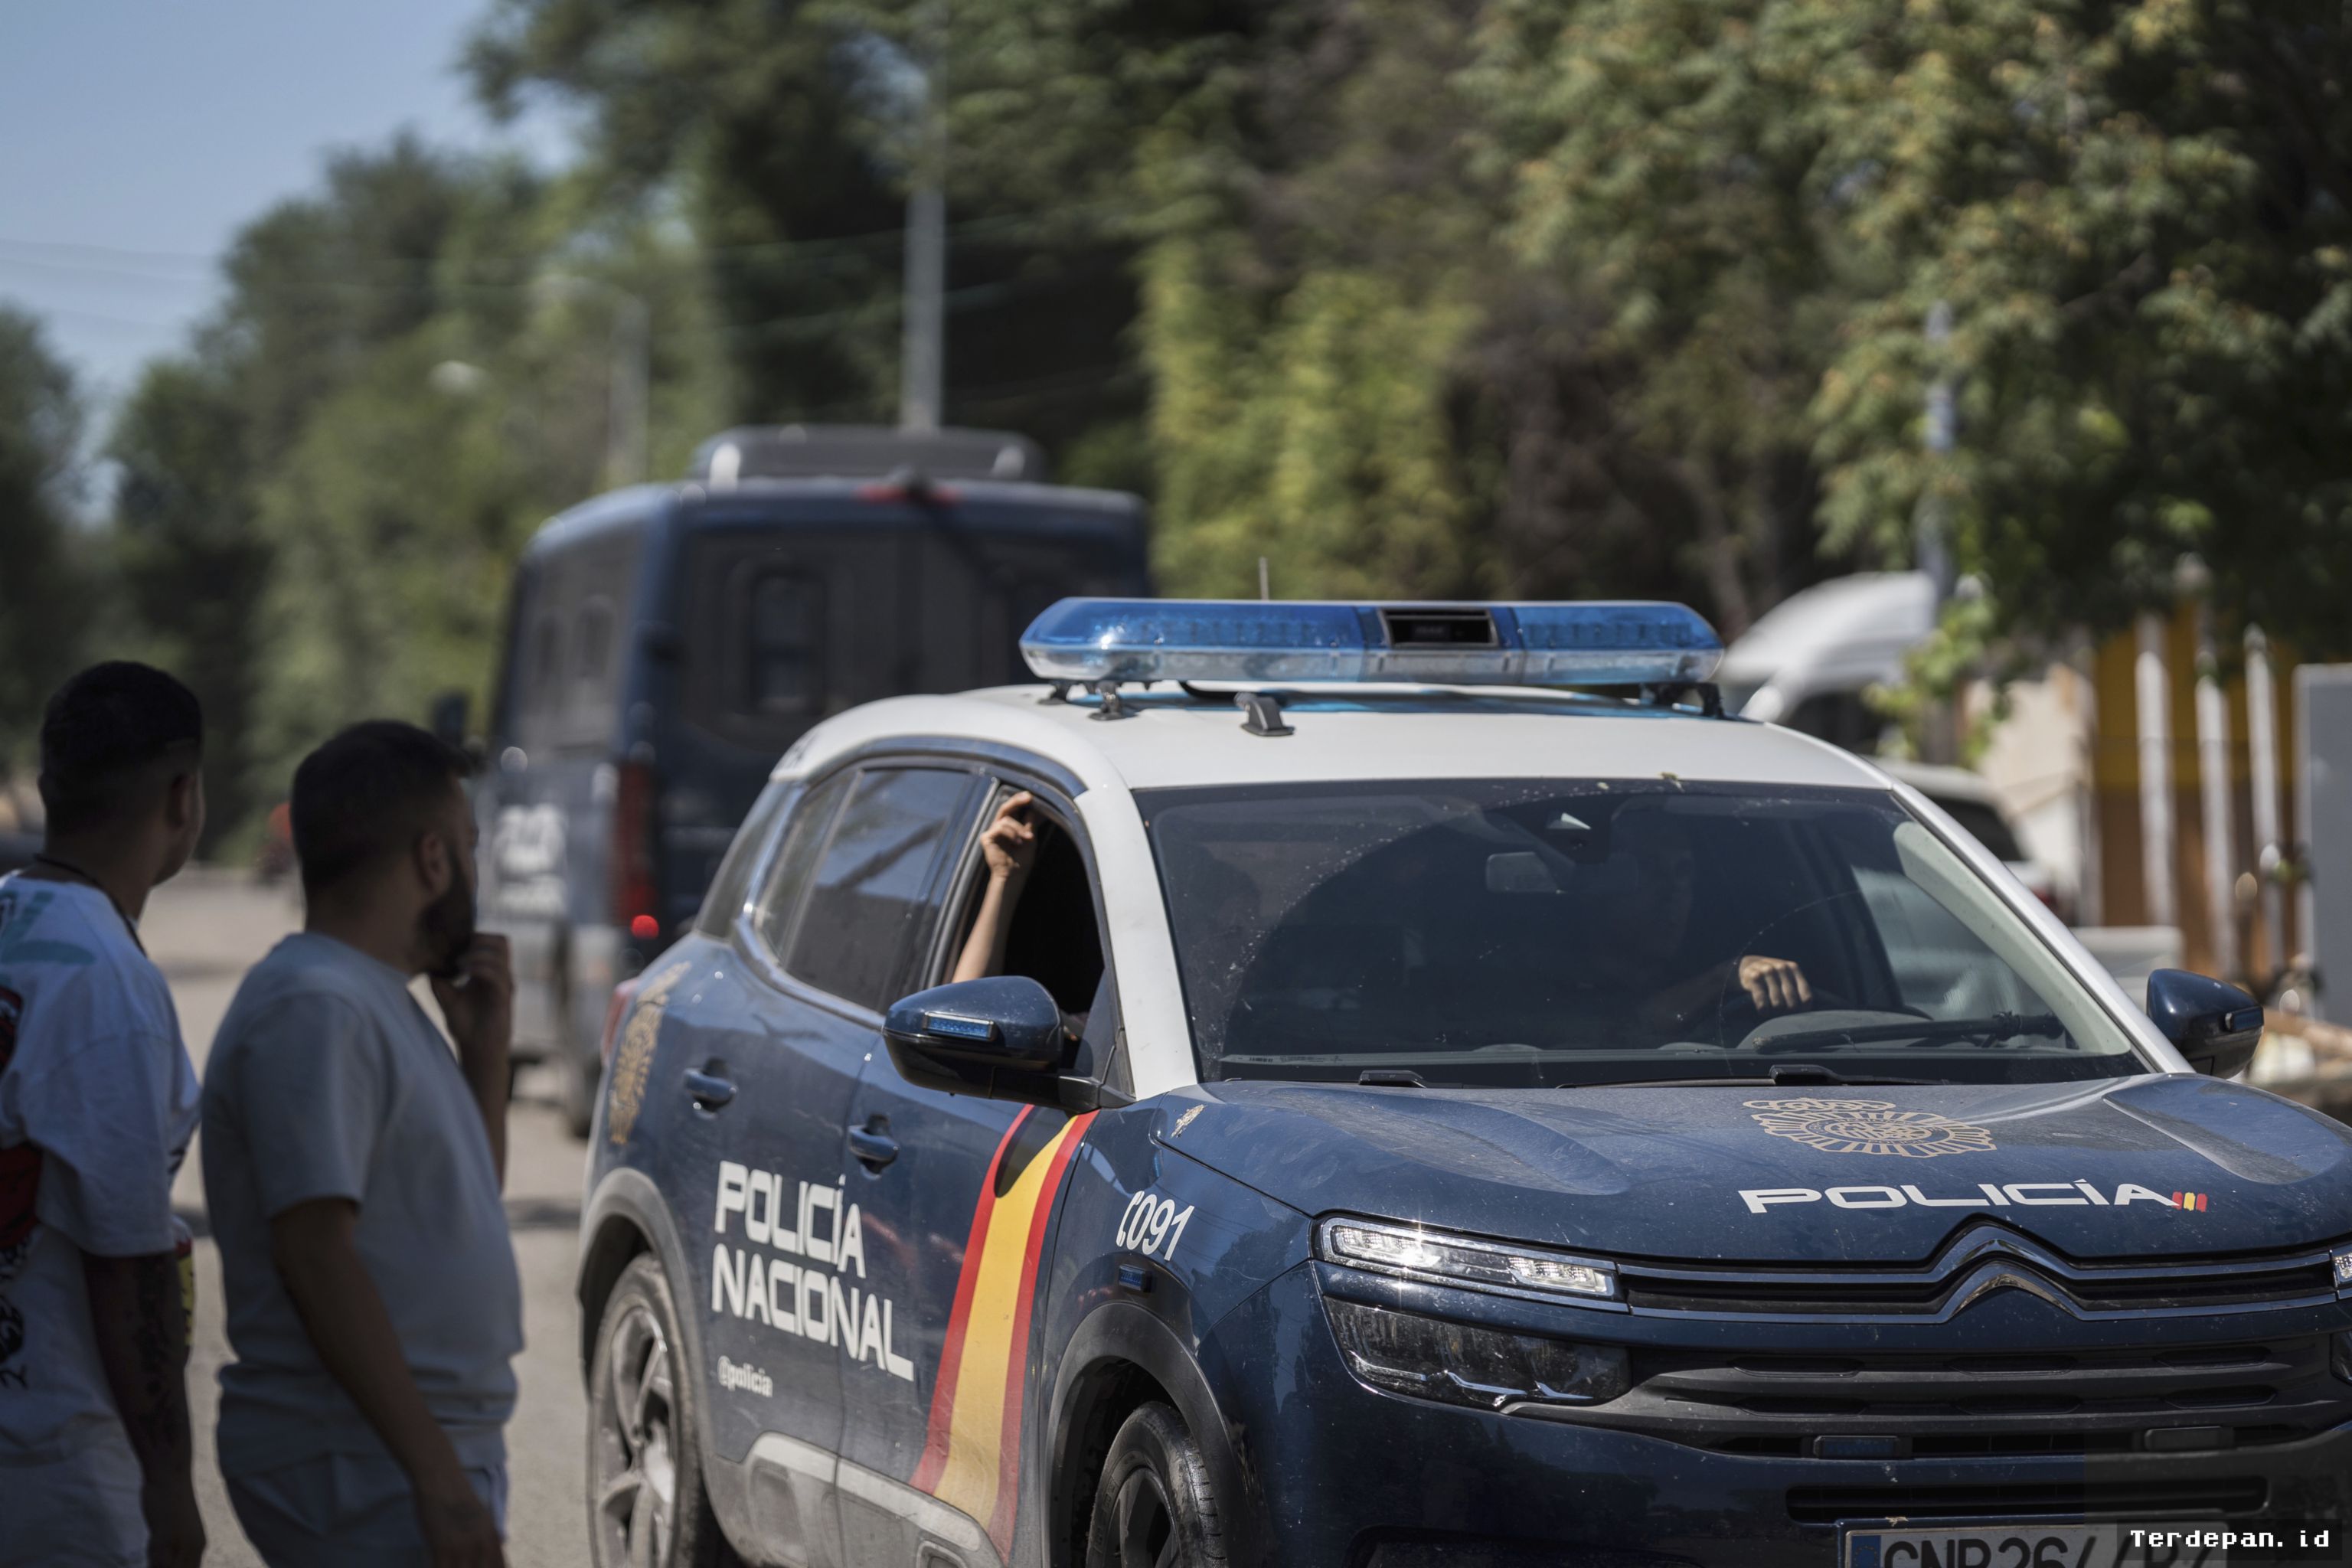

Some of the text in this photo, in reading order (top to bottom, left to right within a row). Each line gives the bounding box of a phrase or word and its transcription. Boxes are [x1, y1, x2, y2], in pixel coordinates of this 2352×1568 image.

[714, 1160, 866, 1279] POLICÍA
[1126, 1194, 1194, 1261] 091
[1738, 1178, 2180, 1214] POLICÍA
[712, 1243, 914, 1381] NACIONAL
